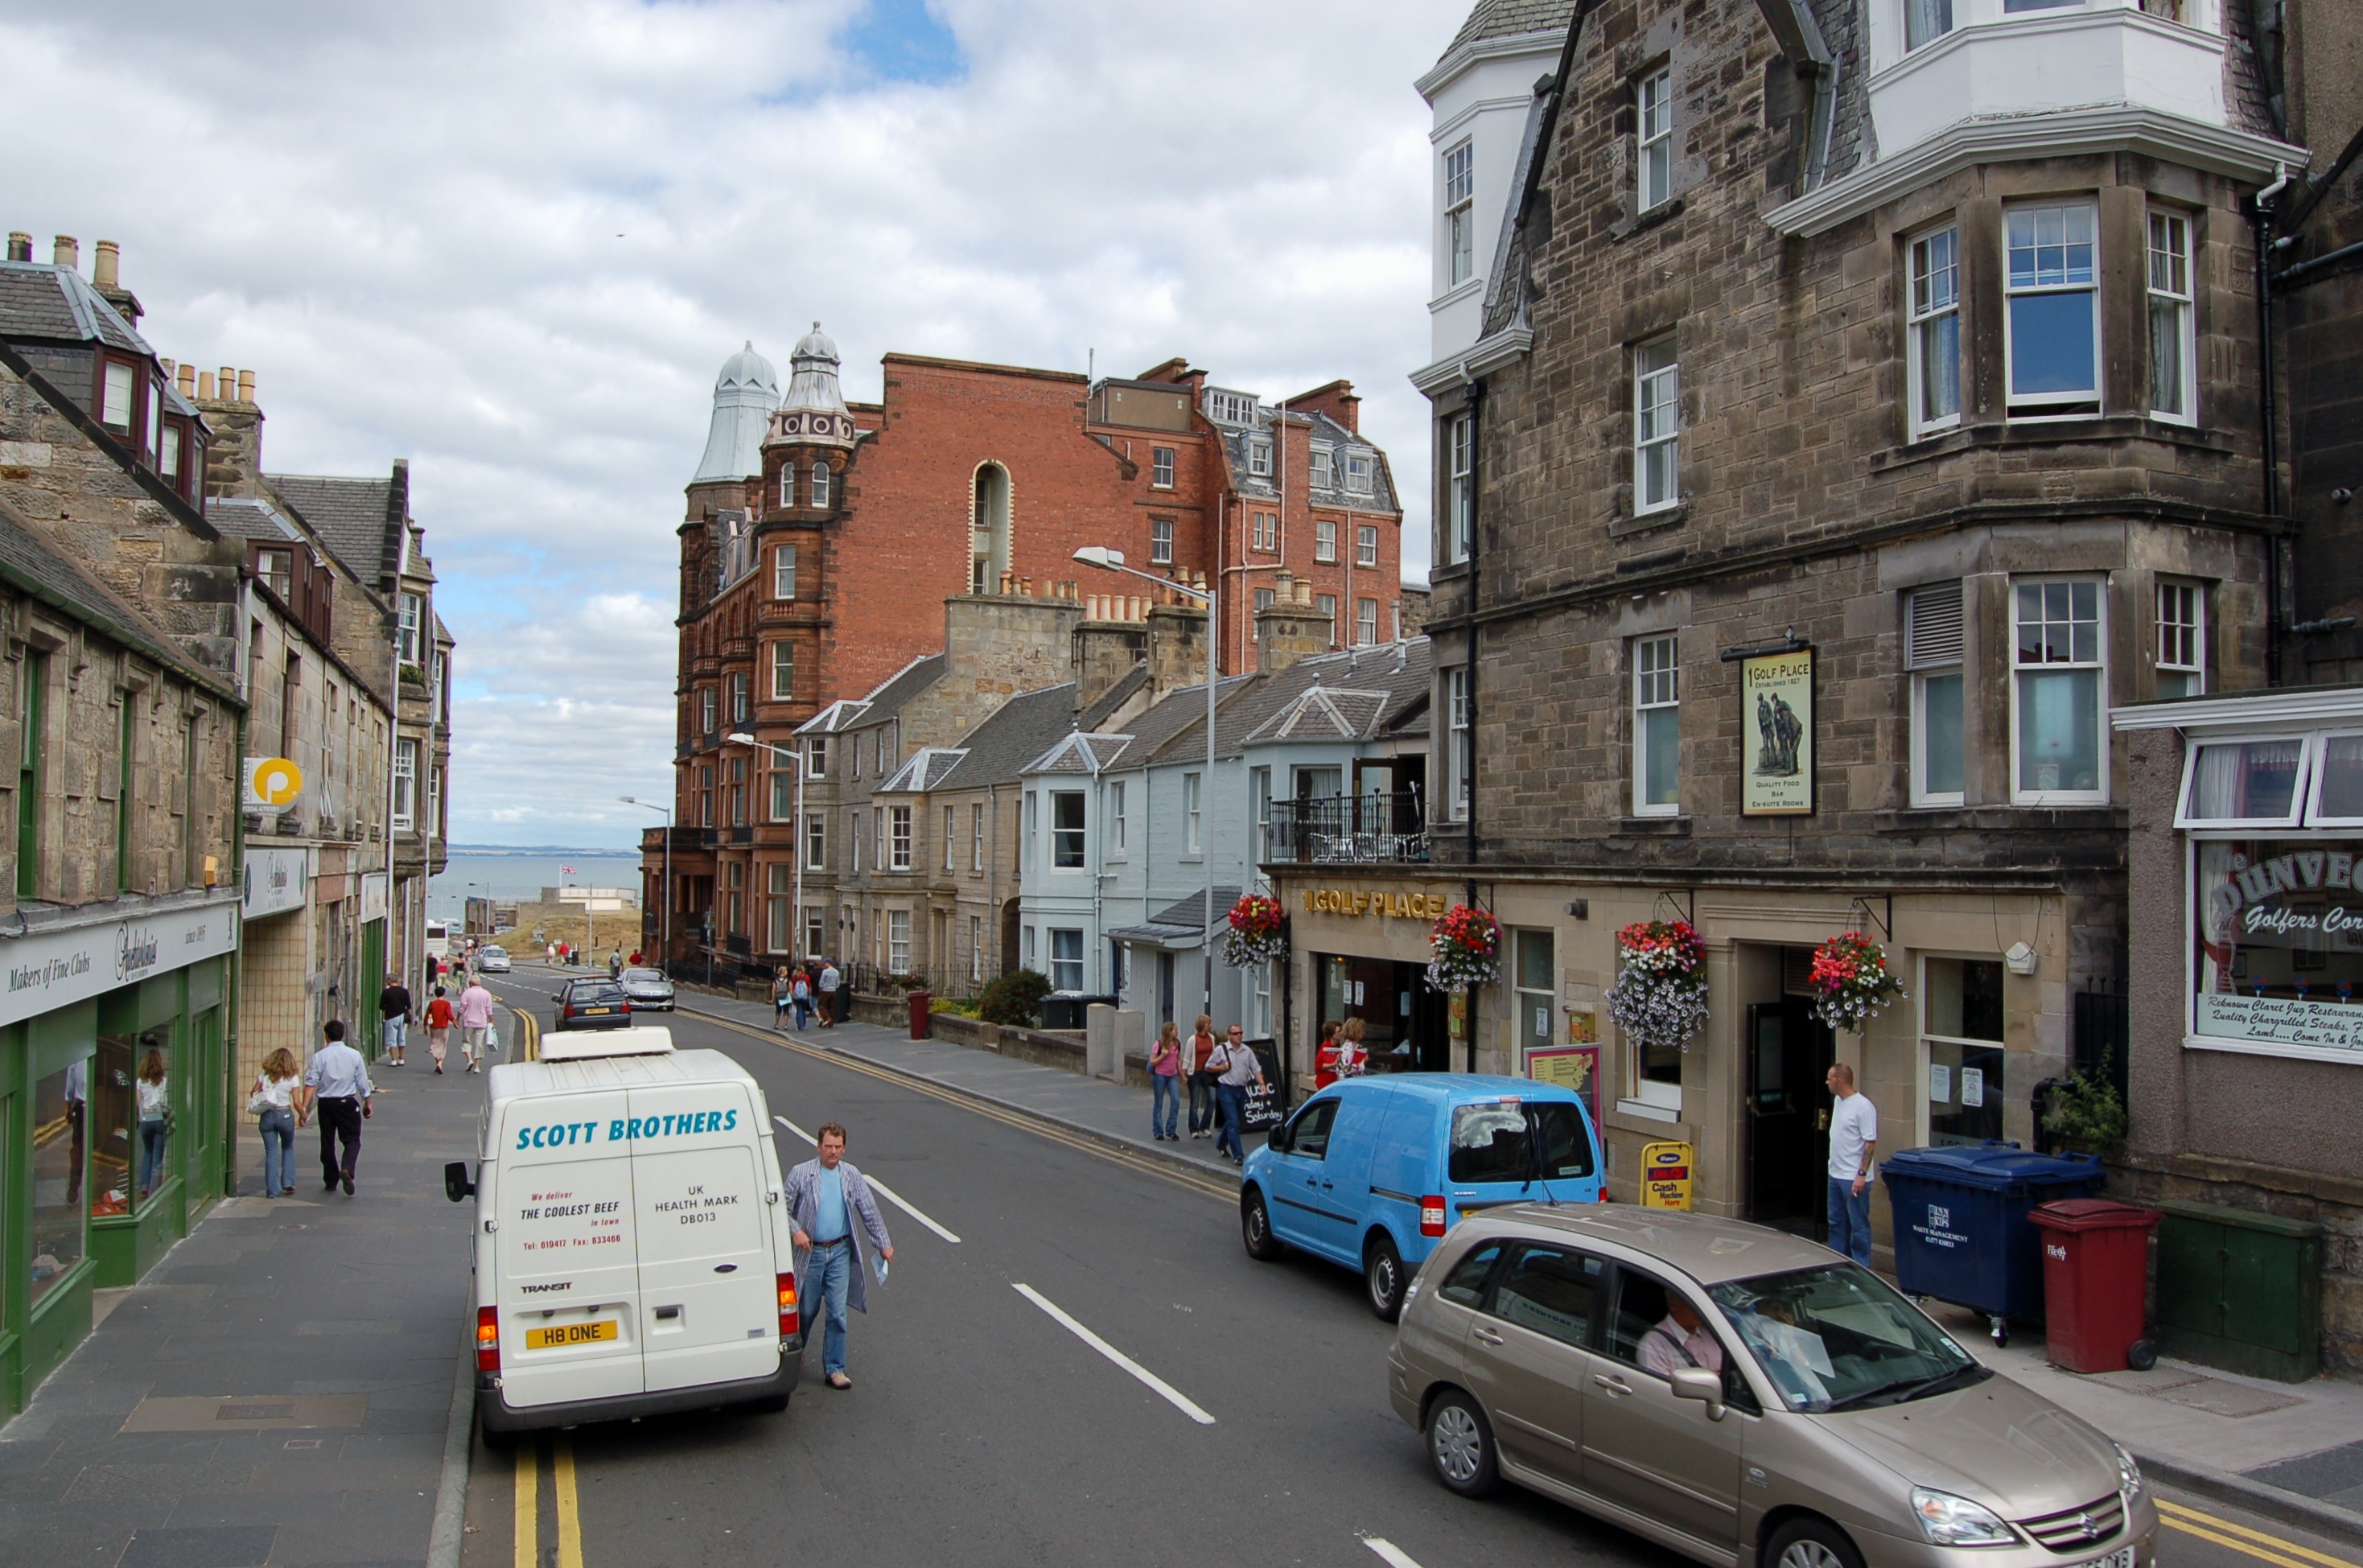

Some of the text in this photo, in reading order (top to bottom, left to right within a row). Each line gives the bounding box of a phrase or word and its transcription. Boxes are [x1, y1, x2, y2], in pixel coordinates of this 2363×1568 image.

[1748, 664, 1809, 687] 1 GOLF PLACE
[1315, 889, 1371, 915] GOLF
[1373, 891, 1447, 919] PLACE
[2245, 905, 2363, 934] Golfers Cor
[9, 951, 91, 993] Makers of Fine Clubs
[2208, 996, 2363, 1019] Reknown Claret Jug Restauran
[2212, 1010, 2247, 1024] Quality
[2292, 1030, 2320, 1043] Come
[2323, 1032, 2335, 1043] In
[2338, 1034, 2347, 1045] &
[1245, 1109, 1283, 1124] Saturday
[516, 1109, 737, 1150] SCOTT BROTHERS
[688, 1185, 704, 1196] UK
[1652, 1182, 1677, 1192] Cash
[531, 1191, 573, 1202] We deliver
[655, 1195, 739, 1212] HEALTH MARK
[521, 1201, 620, 1220] THE COOLEST BEEF
[523, 1234, 621, 1250] Tel: 819417 Fax: 833466
[1929, 1229, 1968, 1242] MANAGEMENT
[521, 1282, 572, 1294] TRANSIT
[570, 1324, 601, 1341] ONE
